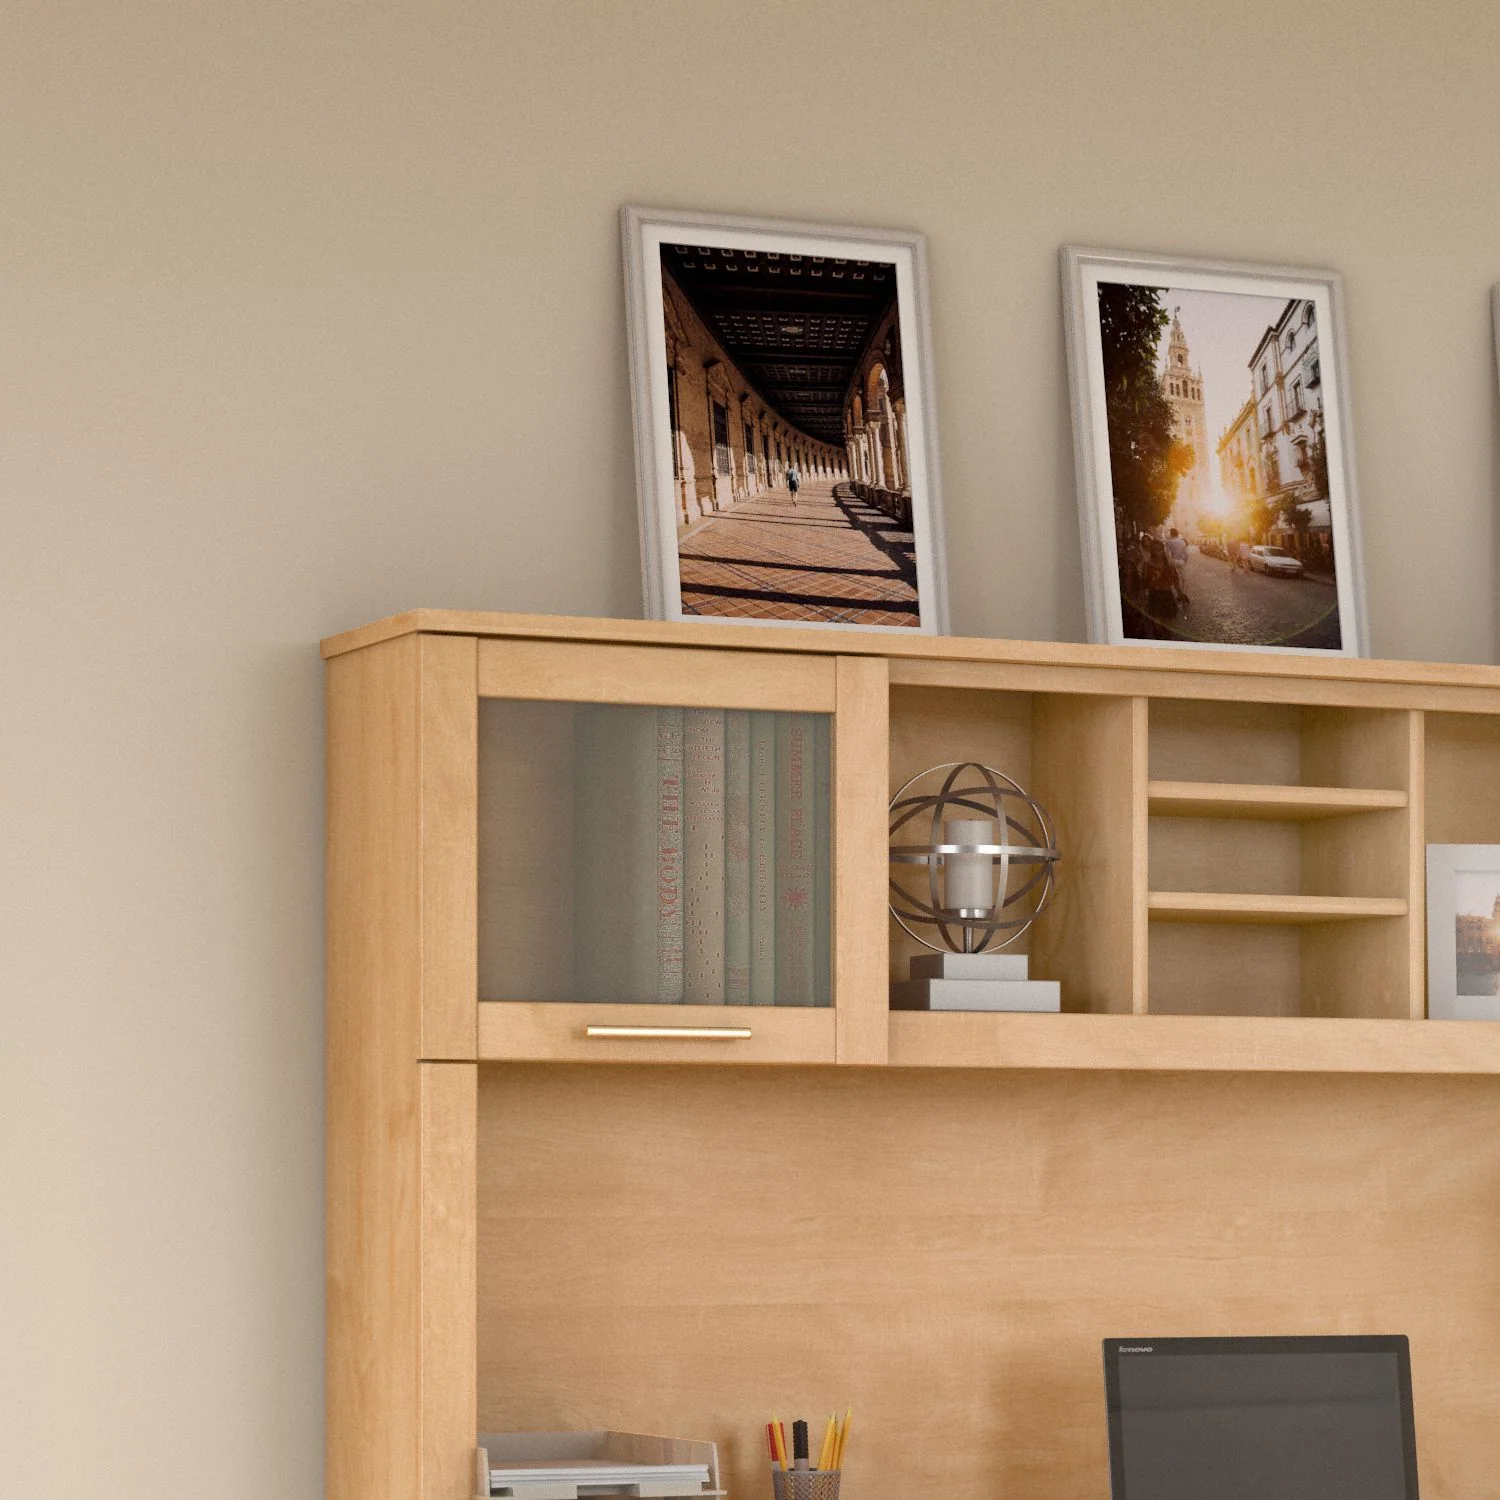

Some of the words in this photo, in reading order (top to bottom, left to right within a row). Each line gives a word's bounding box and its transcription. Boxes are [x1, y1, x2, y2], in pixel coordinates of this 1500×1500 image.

[790, 727, 803, 800] SUMMER
[661, 775, 679, 833] THE
[790, 808, 803, 860] PLACE
[659, 846, 679, 920] BODY
[1118, 1345, 1153, 1353] lenovo
